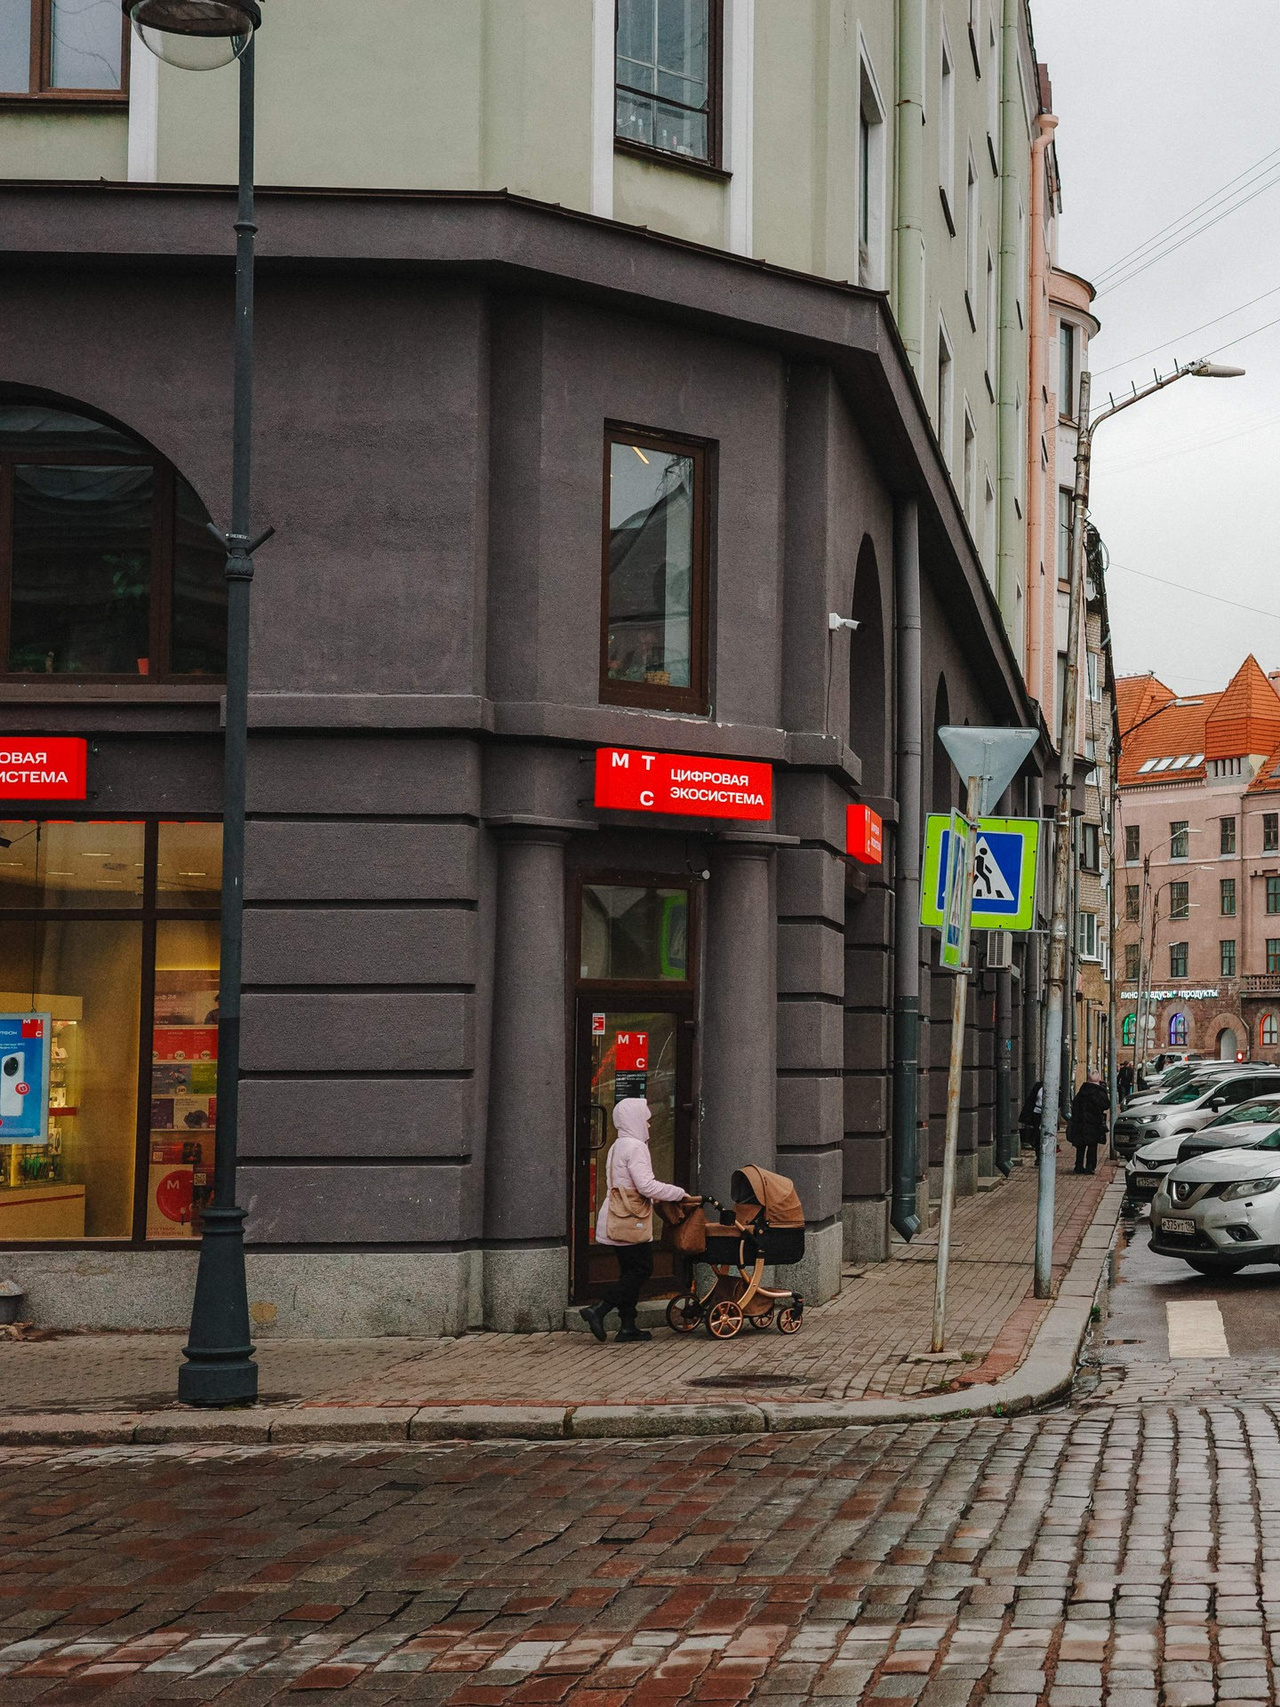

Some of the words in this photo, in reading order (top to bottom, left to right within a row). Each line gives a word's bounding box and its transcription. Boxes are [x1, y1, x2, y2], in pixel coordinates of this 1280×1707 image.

[0, 752, 47, 764] ОВАЯ
[671, 768, 749, 787] ЦИФРОВАЯ
[670, 787, 764, 806] ЭКОСИСТЕМА
